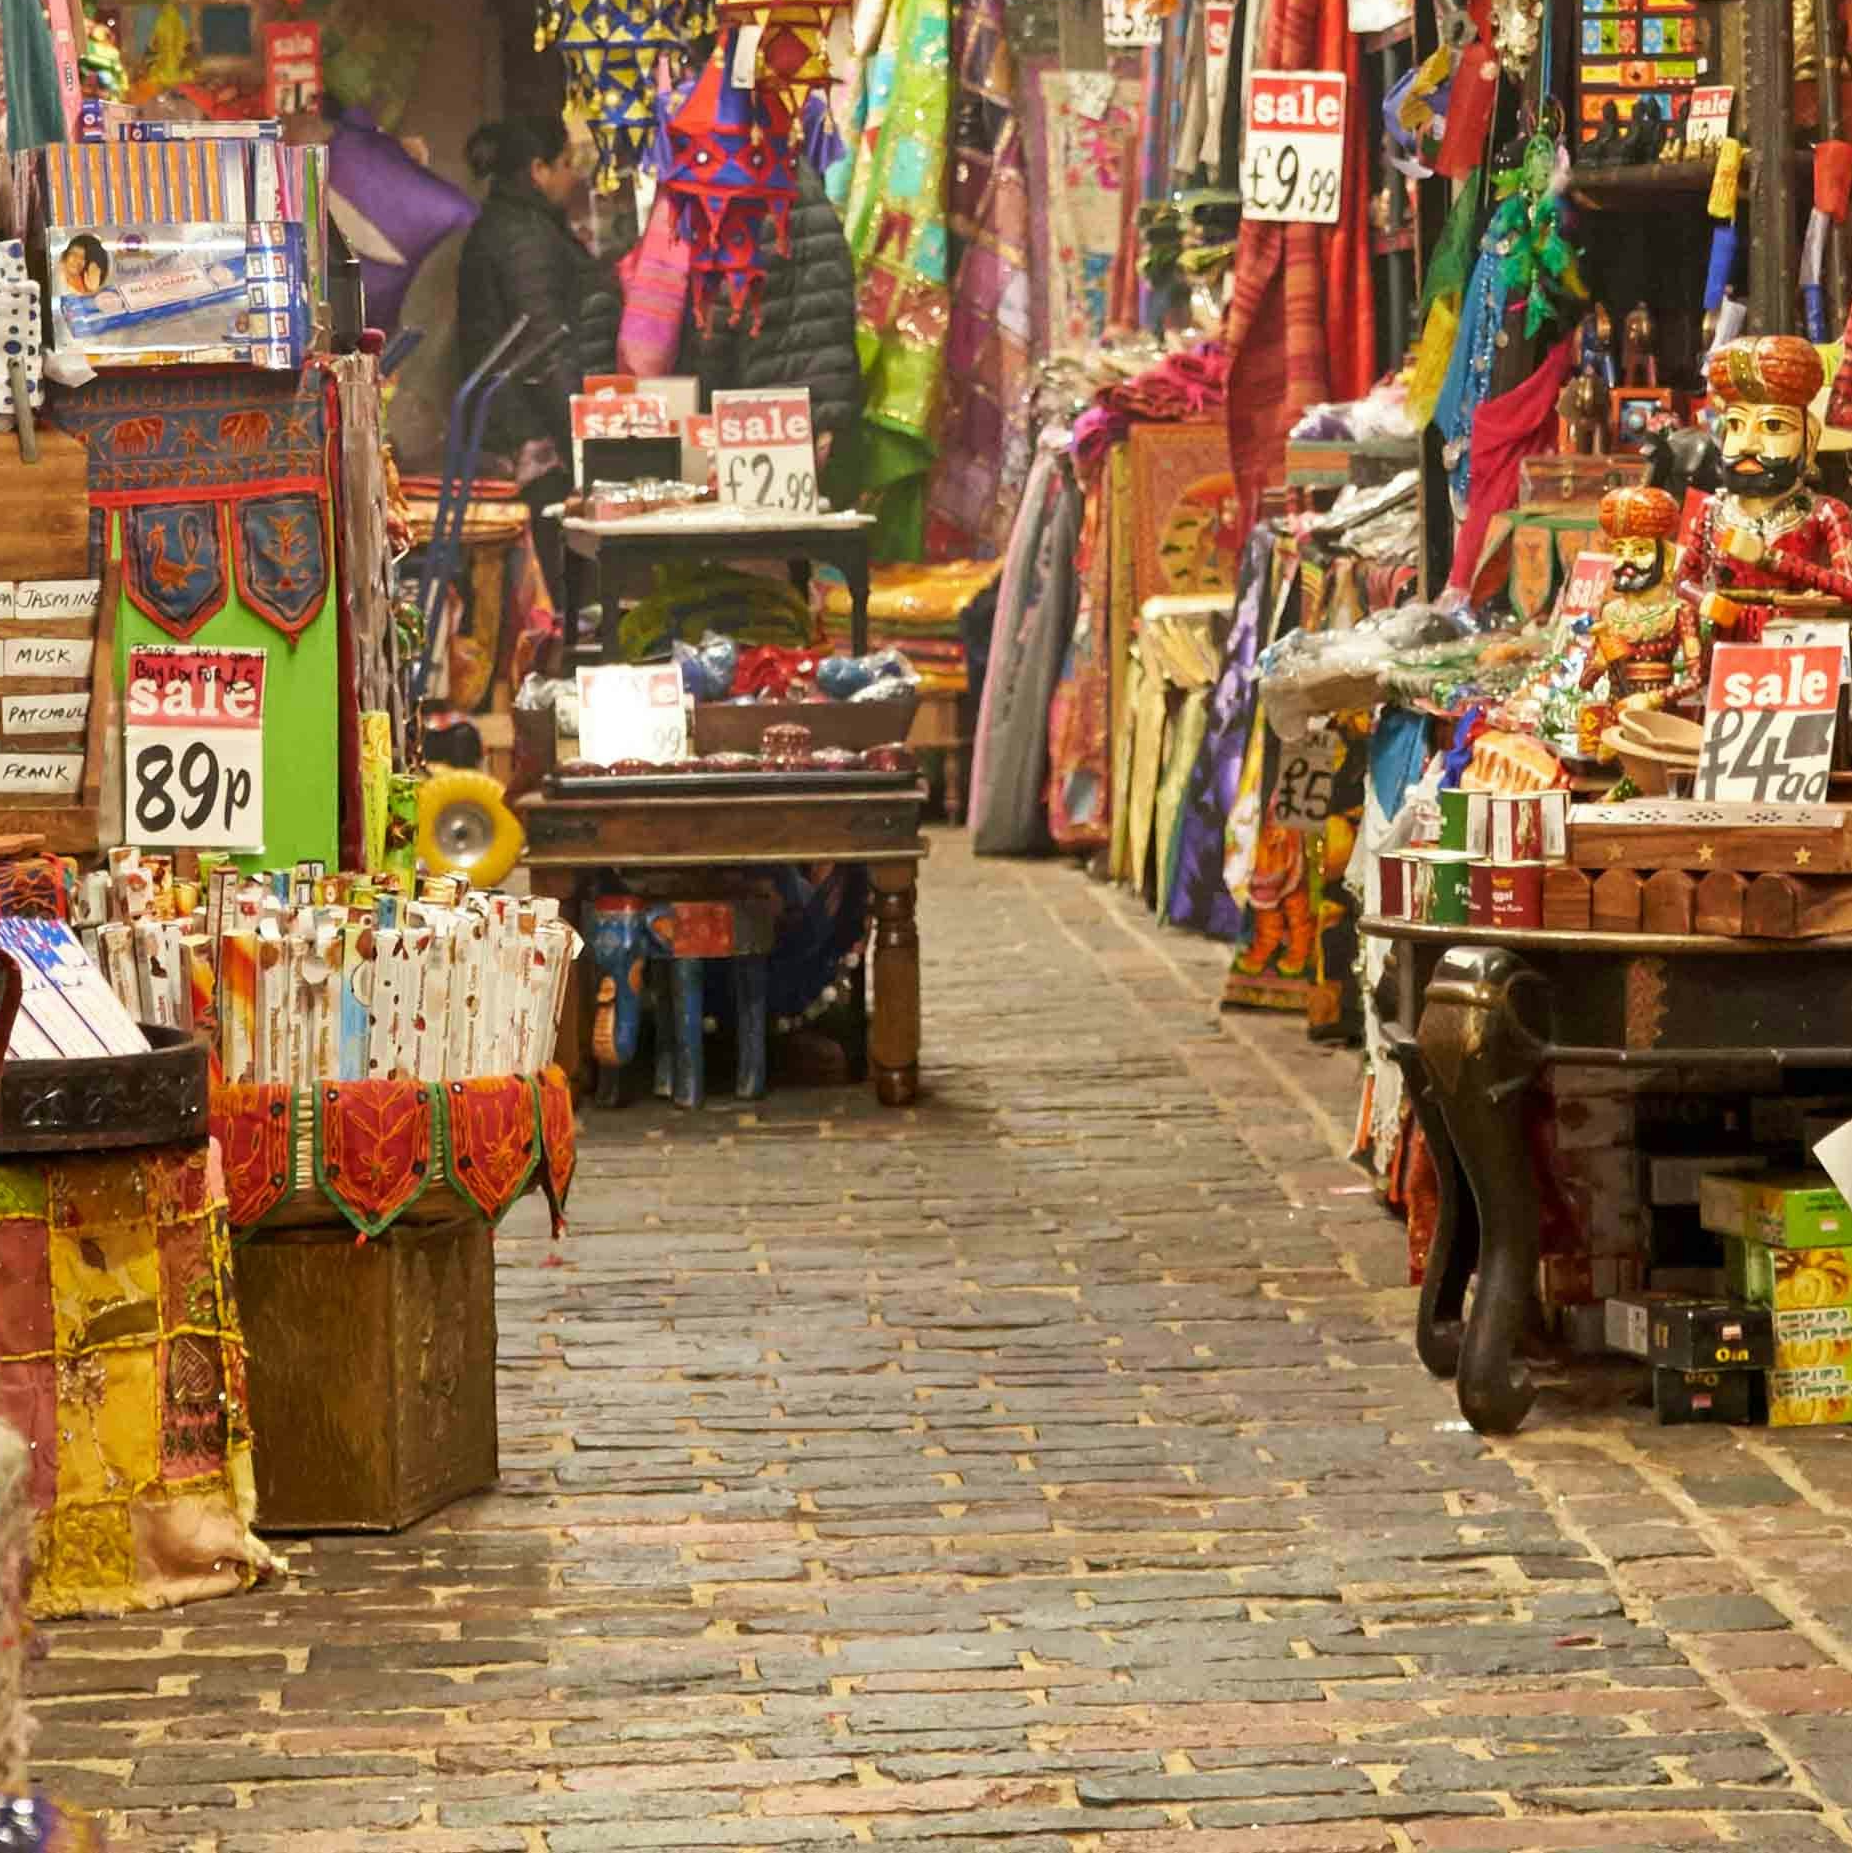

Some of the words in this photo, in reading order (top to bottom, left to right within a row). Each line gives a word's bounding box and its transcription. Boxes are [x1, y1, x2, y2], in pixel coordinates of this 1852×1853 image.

[1252, 84, 1341, 126] sale
[1245, 144, 1338, 213] £9.99
[721, 406, 810, 443] sale
[725, 452, 815, 512] £2.99
[14, 648, 71, 663] MUSK
[129, 665, 257, 718] sale
[1723, 654, 1828, 708] sale
[8, 706, 87, 724] PATCHOUL
[2, 762, 70, 781] FRANK
[135, 741, 252, 833] 89p
